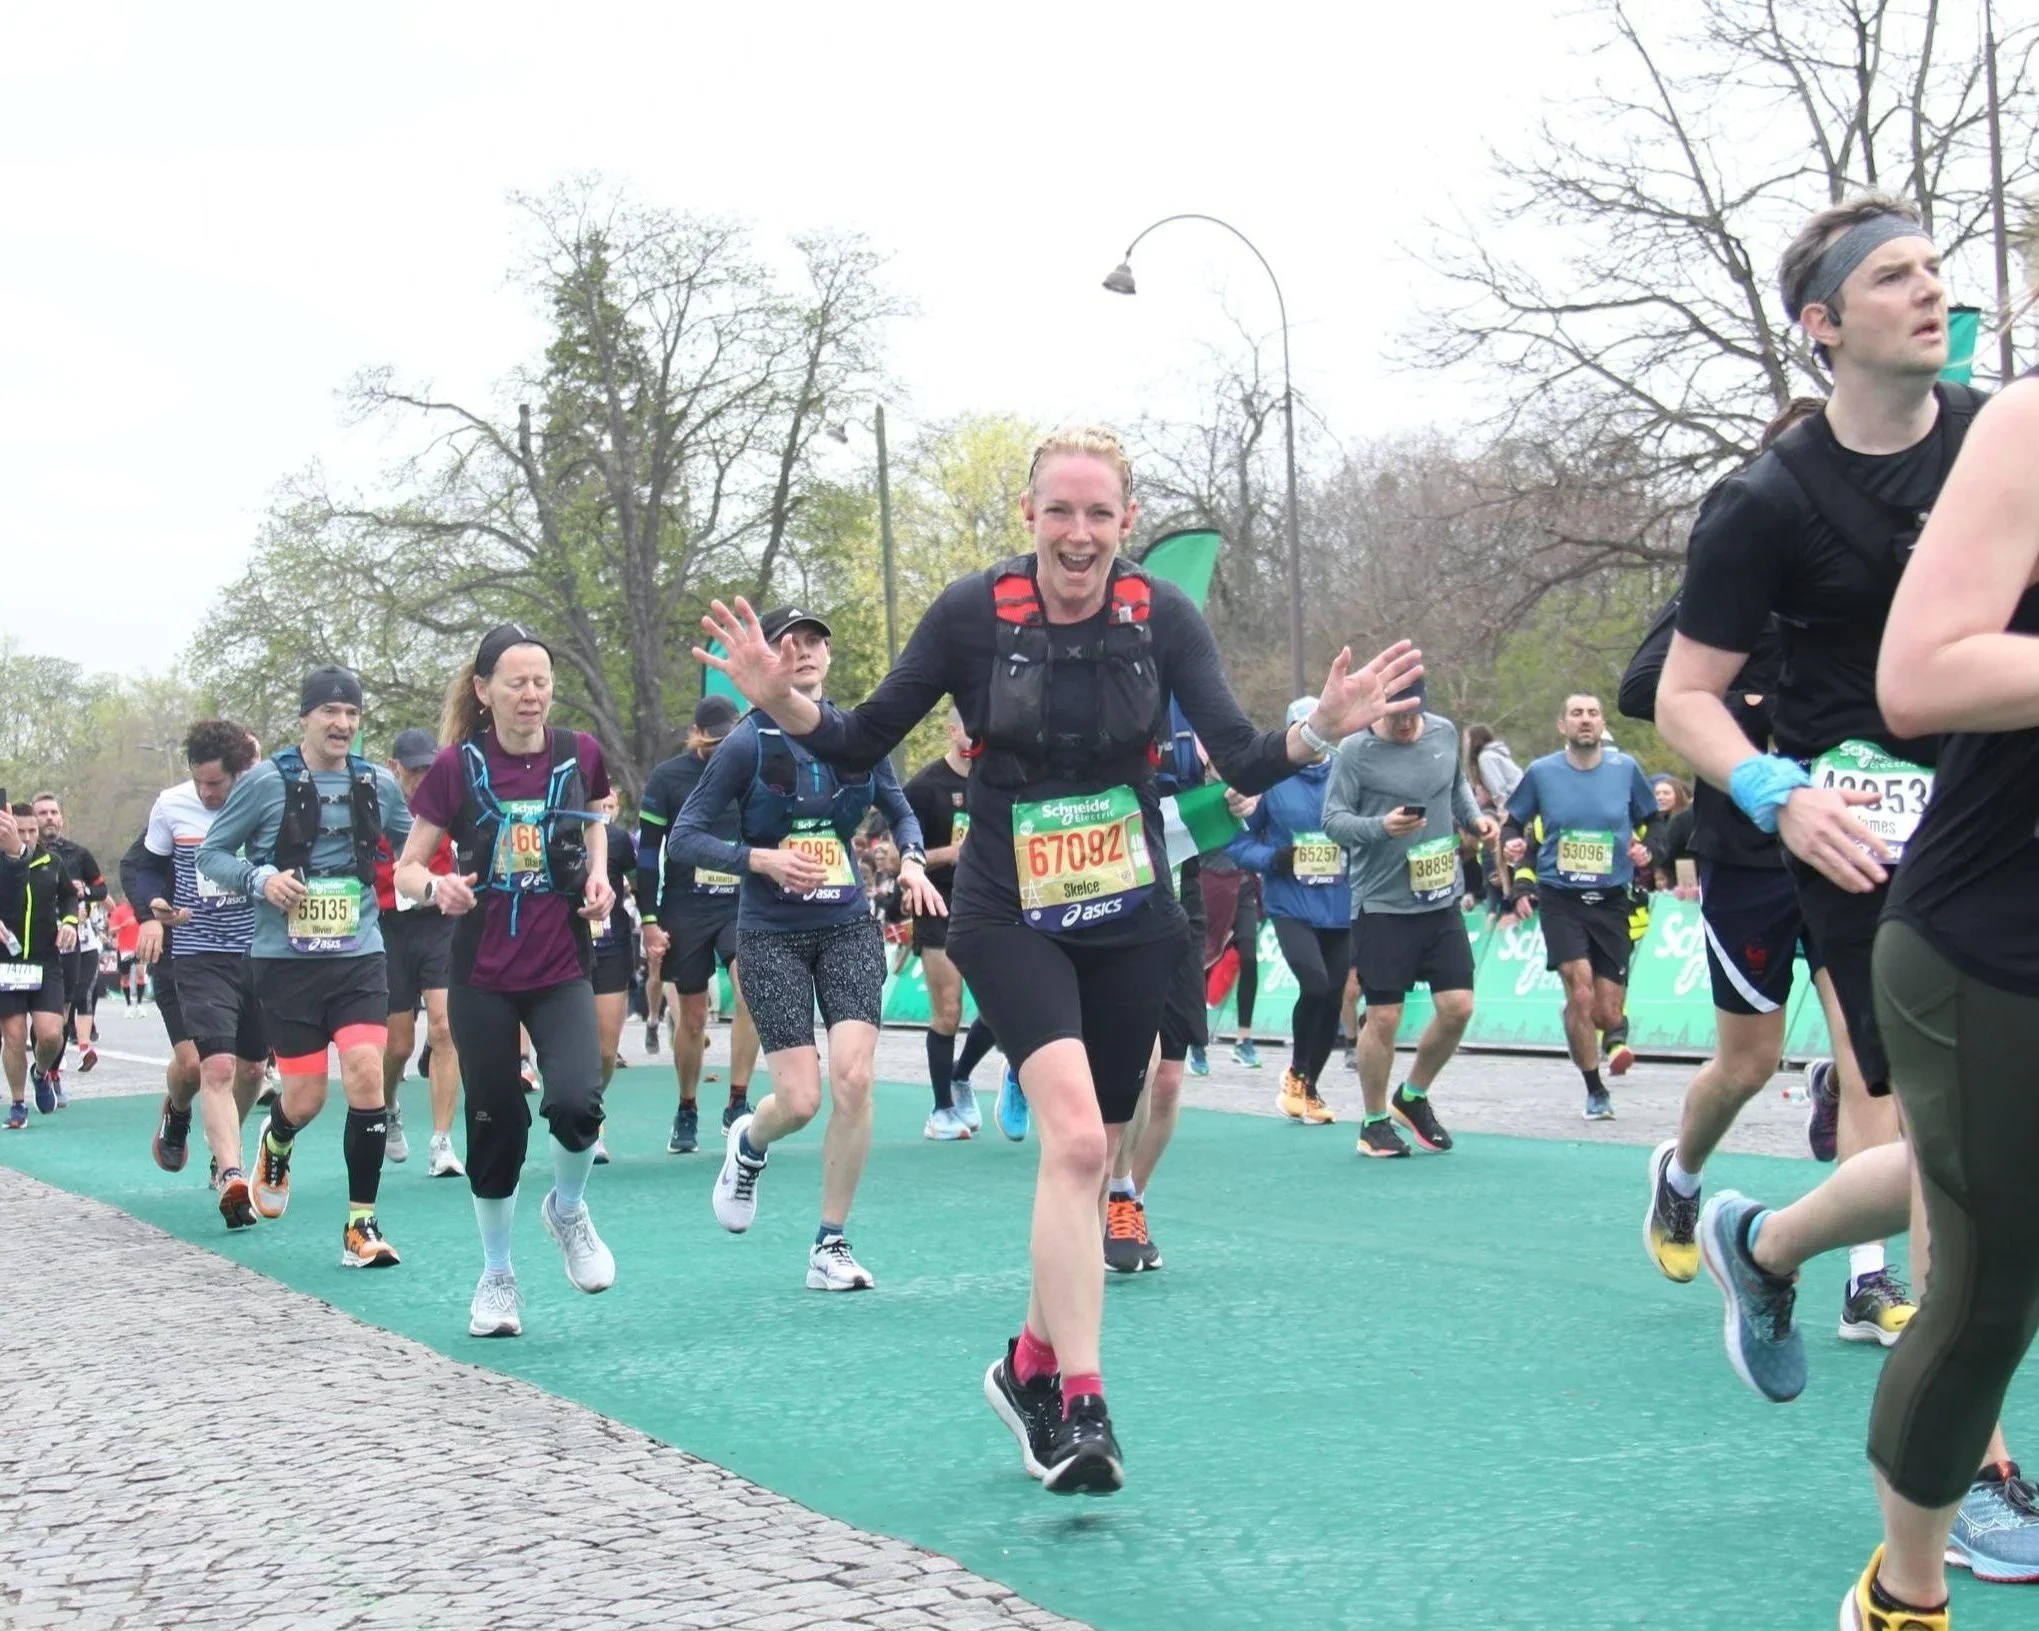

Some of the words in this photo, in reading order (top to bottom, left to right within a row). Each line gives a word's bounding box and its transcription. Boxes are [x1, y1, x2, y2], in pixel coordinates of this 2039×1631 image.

[1041, 799, 1110, 819] Schneider
[1858, 815, 1897, 835] ames
[1028, 823, 1124, 878] 67092
[1299, 846, 1338, 863] 65257
[1562, 842, 1604, 862] 53096
[1415, 852, 1455, 878] 38899
[816, 888, 842, 900] asics
[298, 898, 347, 921] 55135
